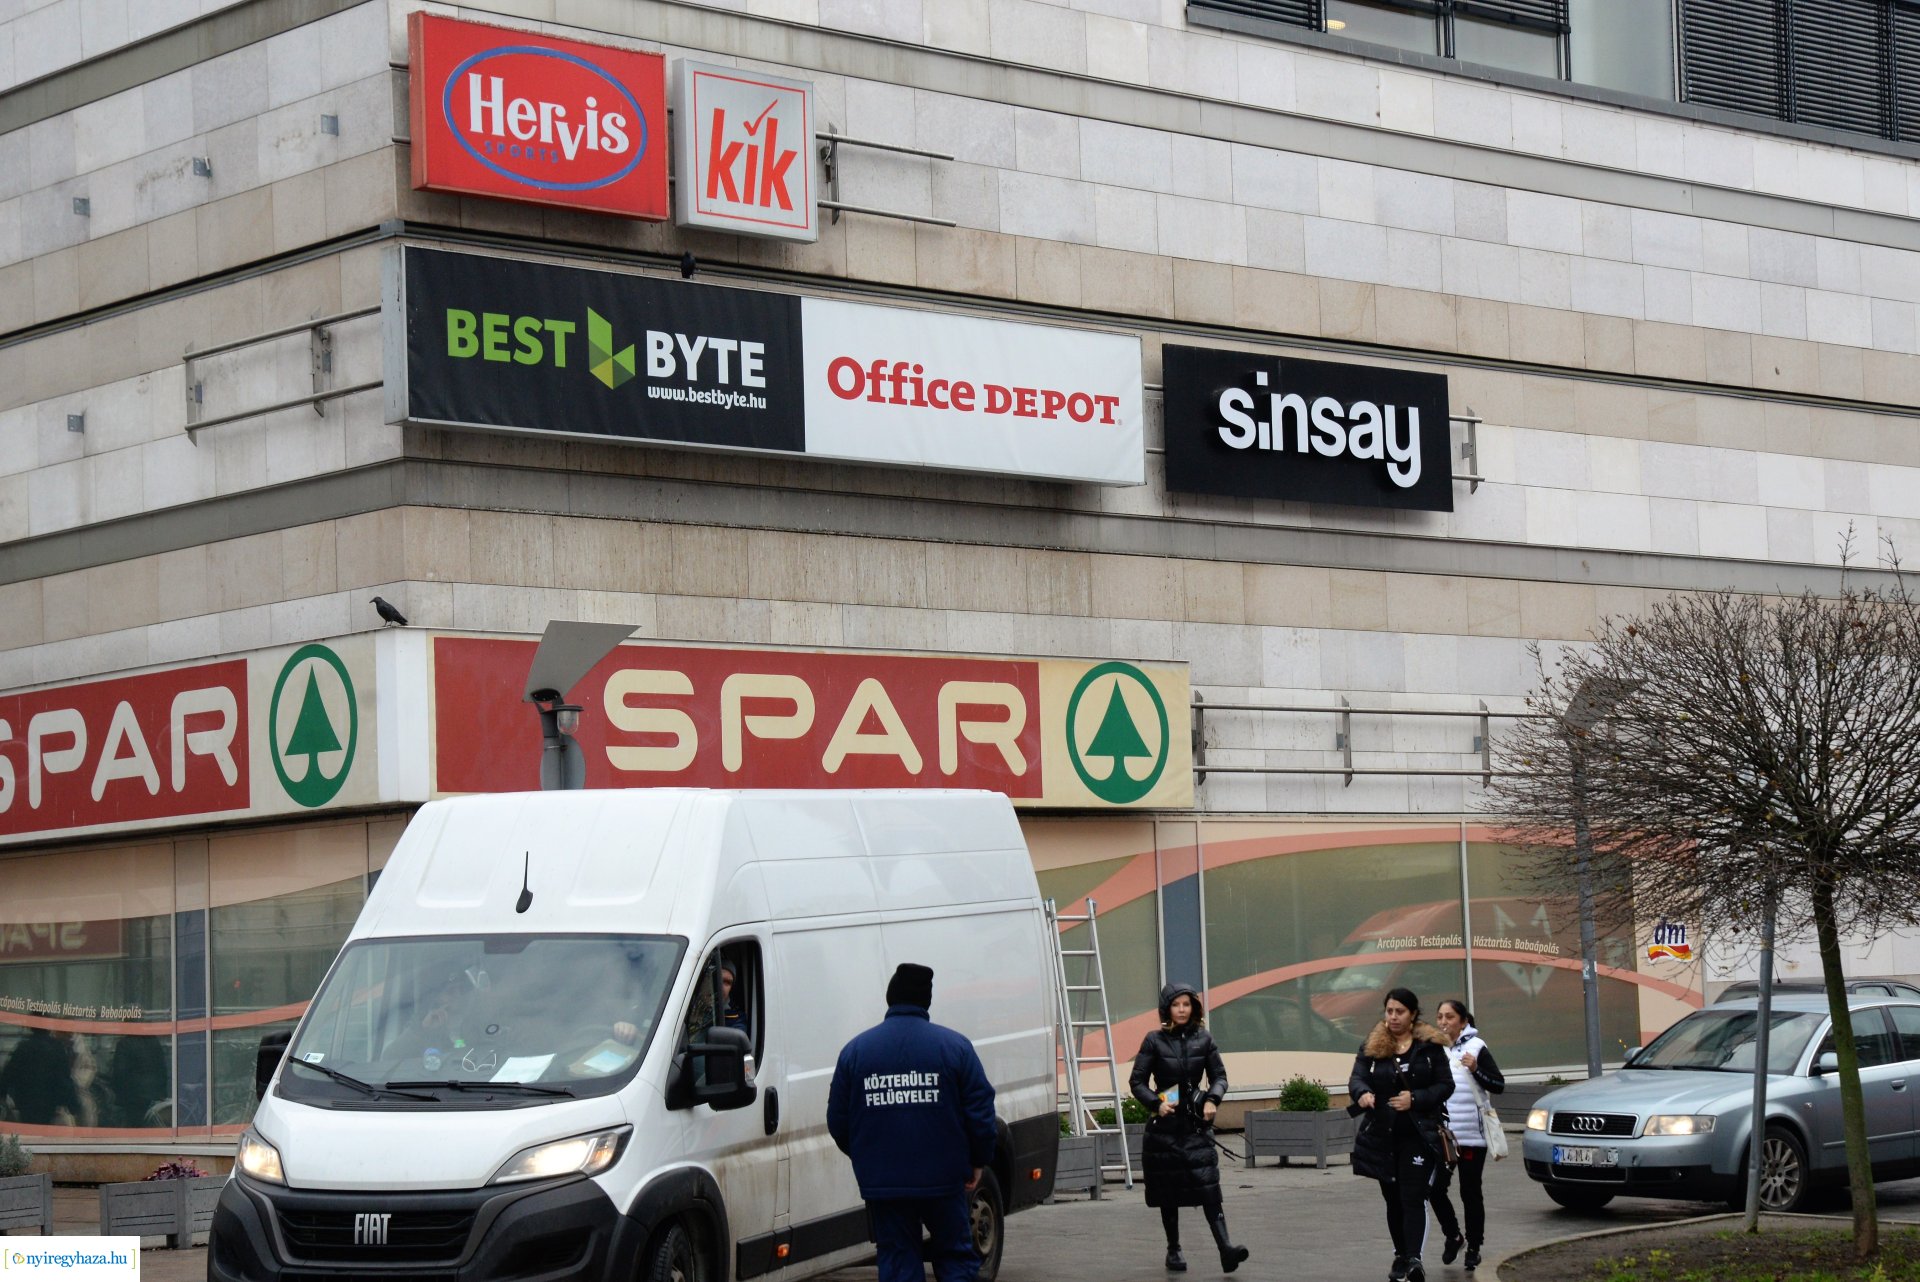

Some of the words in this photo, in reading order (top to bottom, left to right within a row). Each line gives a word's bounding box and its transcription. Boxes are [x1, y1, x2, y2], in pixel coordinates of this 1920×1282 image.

[468, 72, 630, 161] Hervis
[484, 140, 559, 164] SPORTS
[706, 108, 797, 211] kik
[446, 308, 576, 368] BEST
[646, 329, 767, 388] BYTE
[647, 385, 767, 410] www.bestbyte.hu
[827, 356, 976, 412] Office
[983, 383, 1120, 425] DEPOT
[603, 669, 1027, 777] SPAR
[0, 686, 238, 813] PAR
[1377, 936, 1417, 950] Arcápolás
[1420, 934, 1462, 950] Testápolás
[1473, 935, 1512, 949] Háztartás
[1514, 938, 1560, 955] Babaápolás
[1654, 915, 1686, 945] dm
[26, 998, 61, 1016] Testápolás
[62, 1002, 97, 1018] Háztartás
[864, 1070, 940, 1090] KÖZTERÜLET
[866, 1089, 940, 1106] FELÜGYELET
[354, 1213, 392, 1245] FIAT
